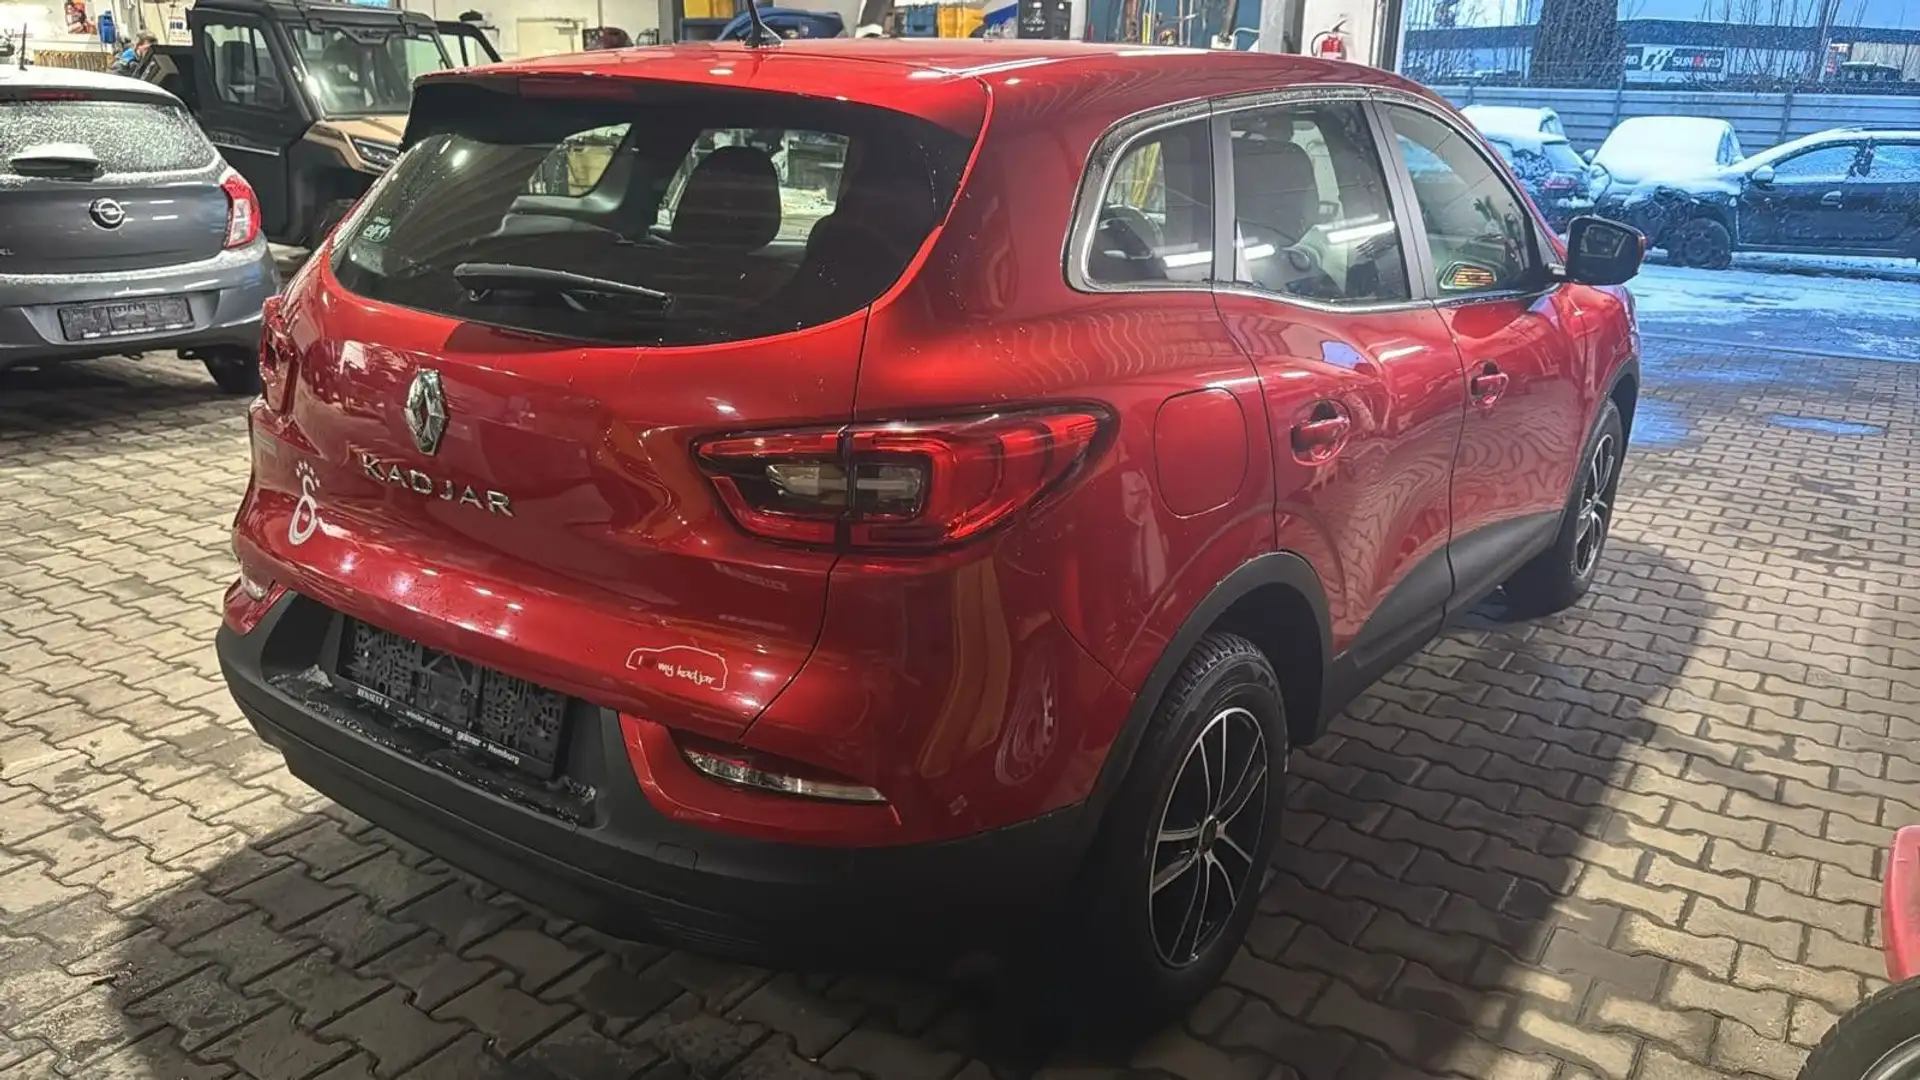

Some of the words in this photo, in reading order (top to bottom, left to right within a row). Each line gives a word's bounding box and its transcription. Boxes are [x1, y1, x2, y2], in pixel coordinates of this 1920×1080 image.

[362, 452, 514, 518] KADJAR
[658, 662, 674, 677] my
[677, 665, 716, 685] kadjar
